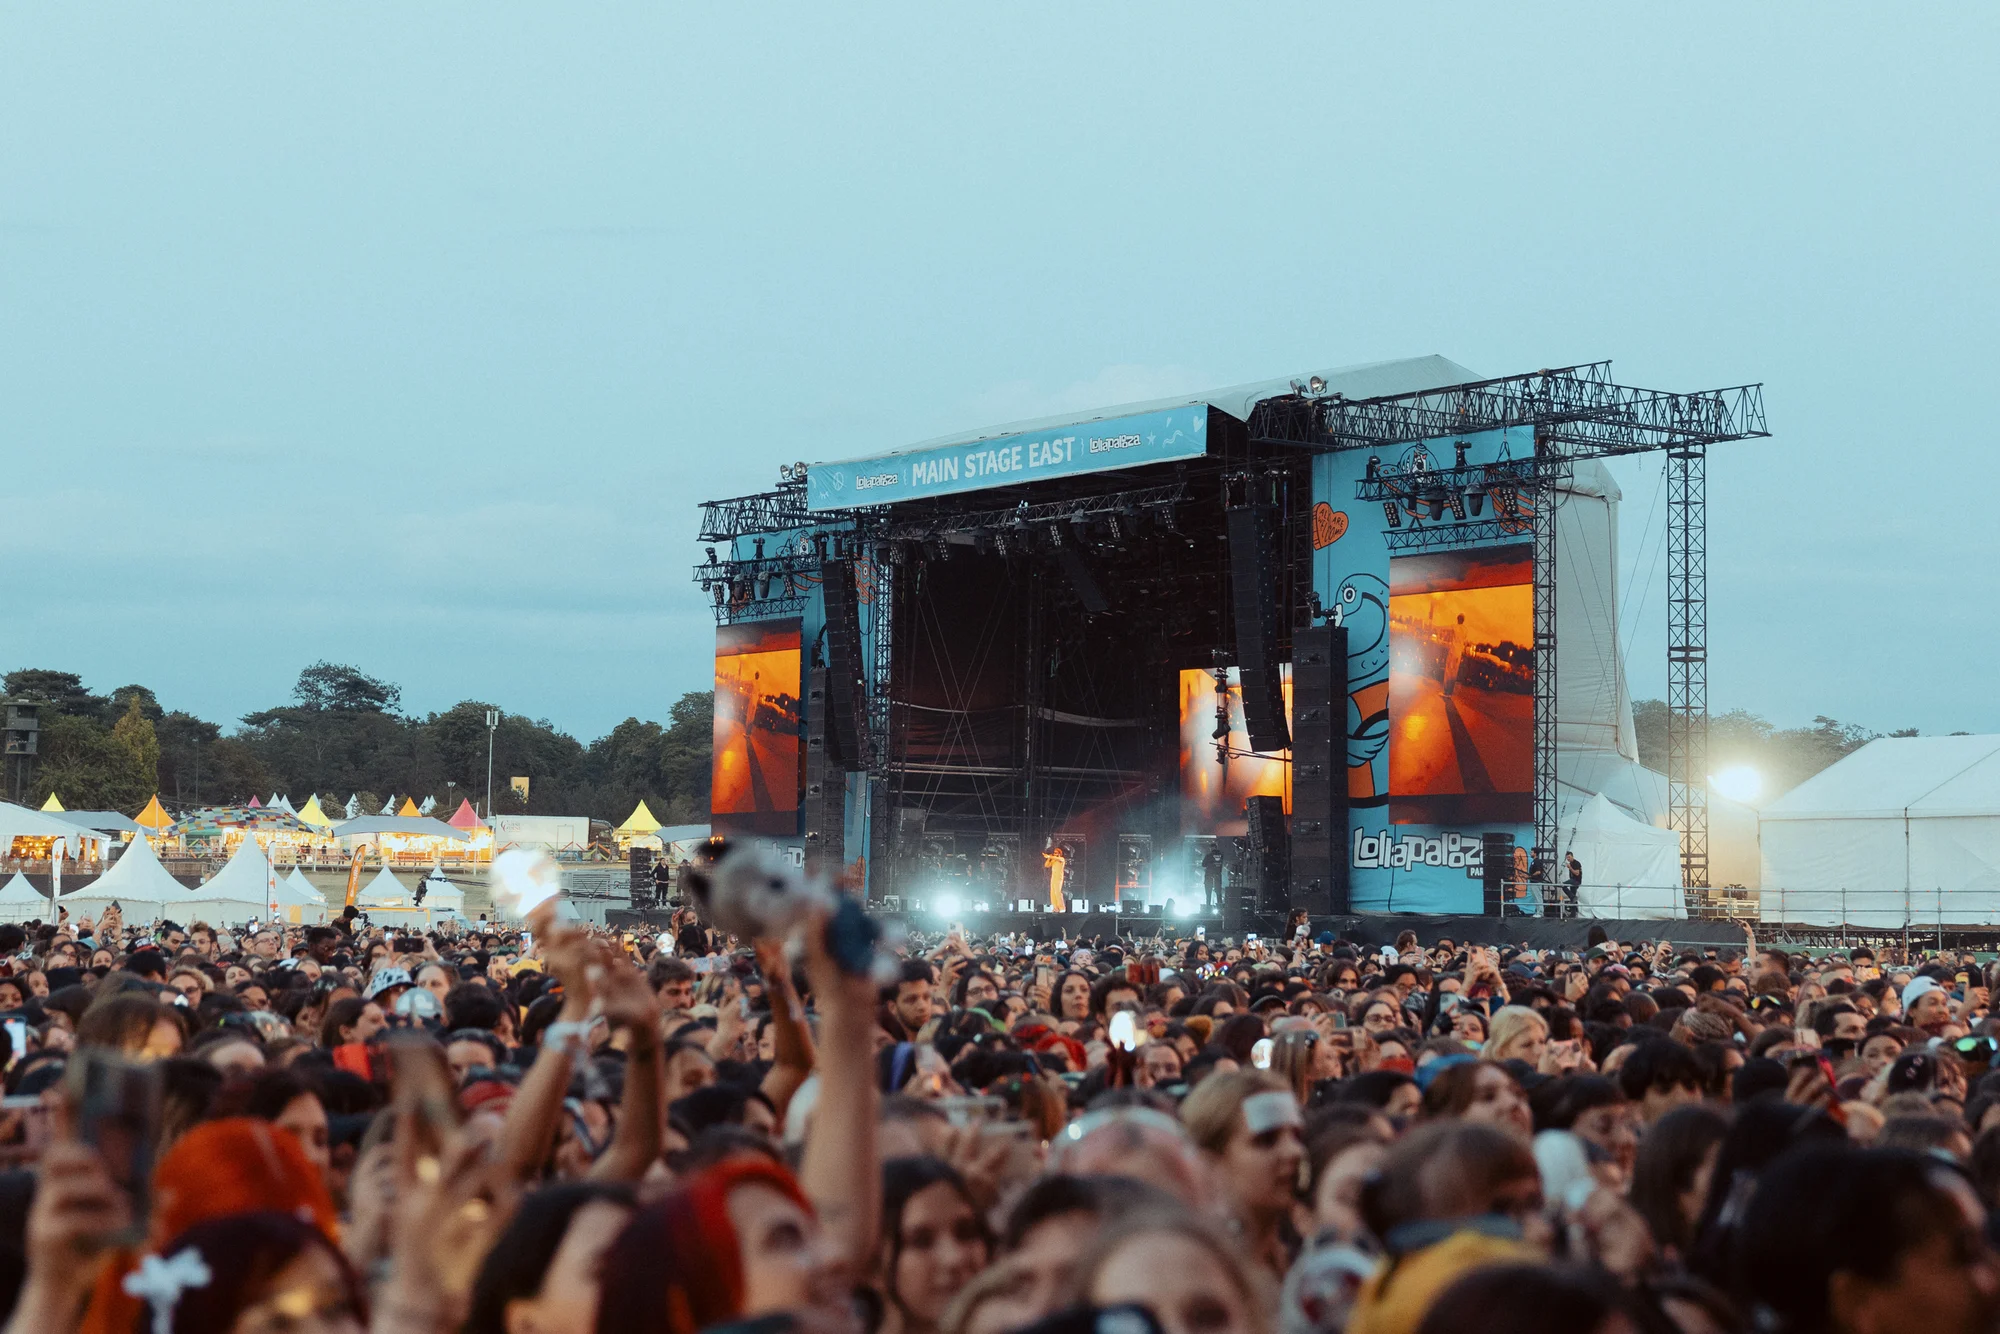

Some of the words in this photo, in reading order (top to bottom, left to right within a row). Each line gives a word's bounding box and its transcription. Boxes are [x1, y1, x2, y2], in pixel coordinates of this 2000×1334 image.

[912, 456, 958, 487] MAIN
[964, 445, 1022, 478] STAGE
[1028, 437, 1076, 468] EAST
[1332, 516, 1344, 527] ARE
[1353, 826, 1484, 872] Lollapalooz
